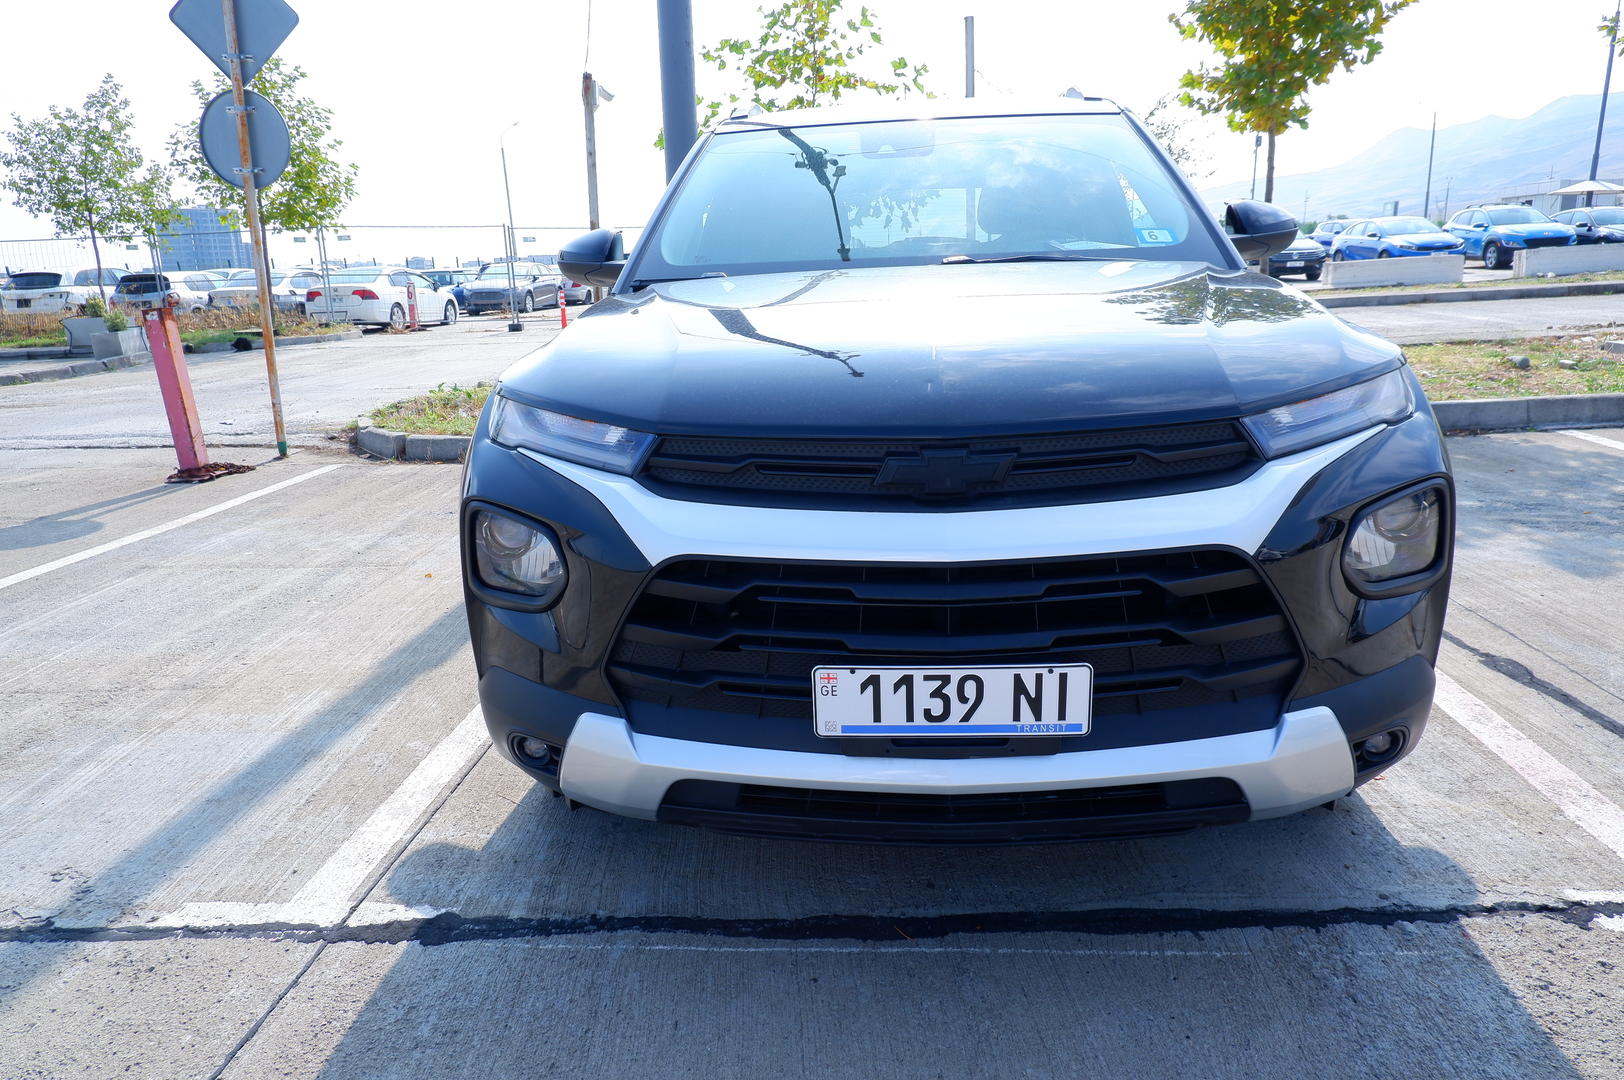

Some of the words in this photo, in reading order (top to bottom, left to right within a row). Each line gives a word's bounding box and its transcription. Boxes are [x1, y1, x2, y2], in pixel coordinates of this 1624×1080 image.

[1147, 230, 1159, 241] 6
[820, 685, 838, 697] GE
[859, 673, 985, 723] 1139
[1012, 672, 1069, 722] NI
[1016, 724, 1068, 733] TRANSIT
